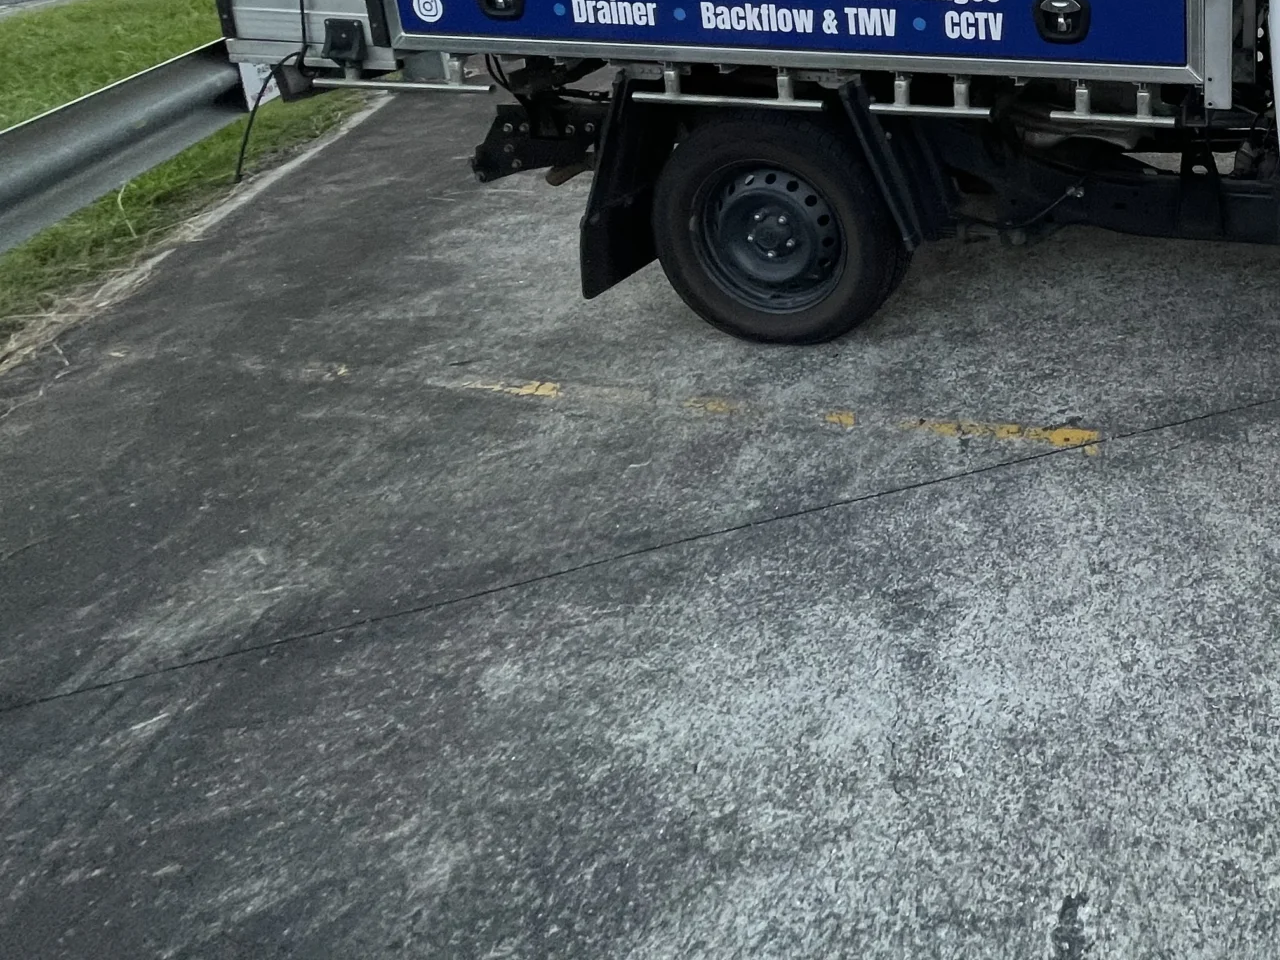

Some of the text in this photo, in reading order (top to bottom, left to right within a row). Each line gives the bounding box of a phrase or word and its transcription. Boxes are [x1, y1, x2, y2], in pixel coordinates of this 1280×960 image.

[700, 1, 813, 34] Backflow
[822, 9, 838, 34] &
[844, 6, 896, 37] TMV
[944, 10, 1003, 41] CCTV
